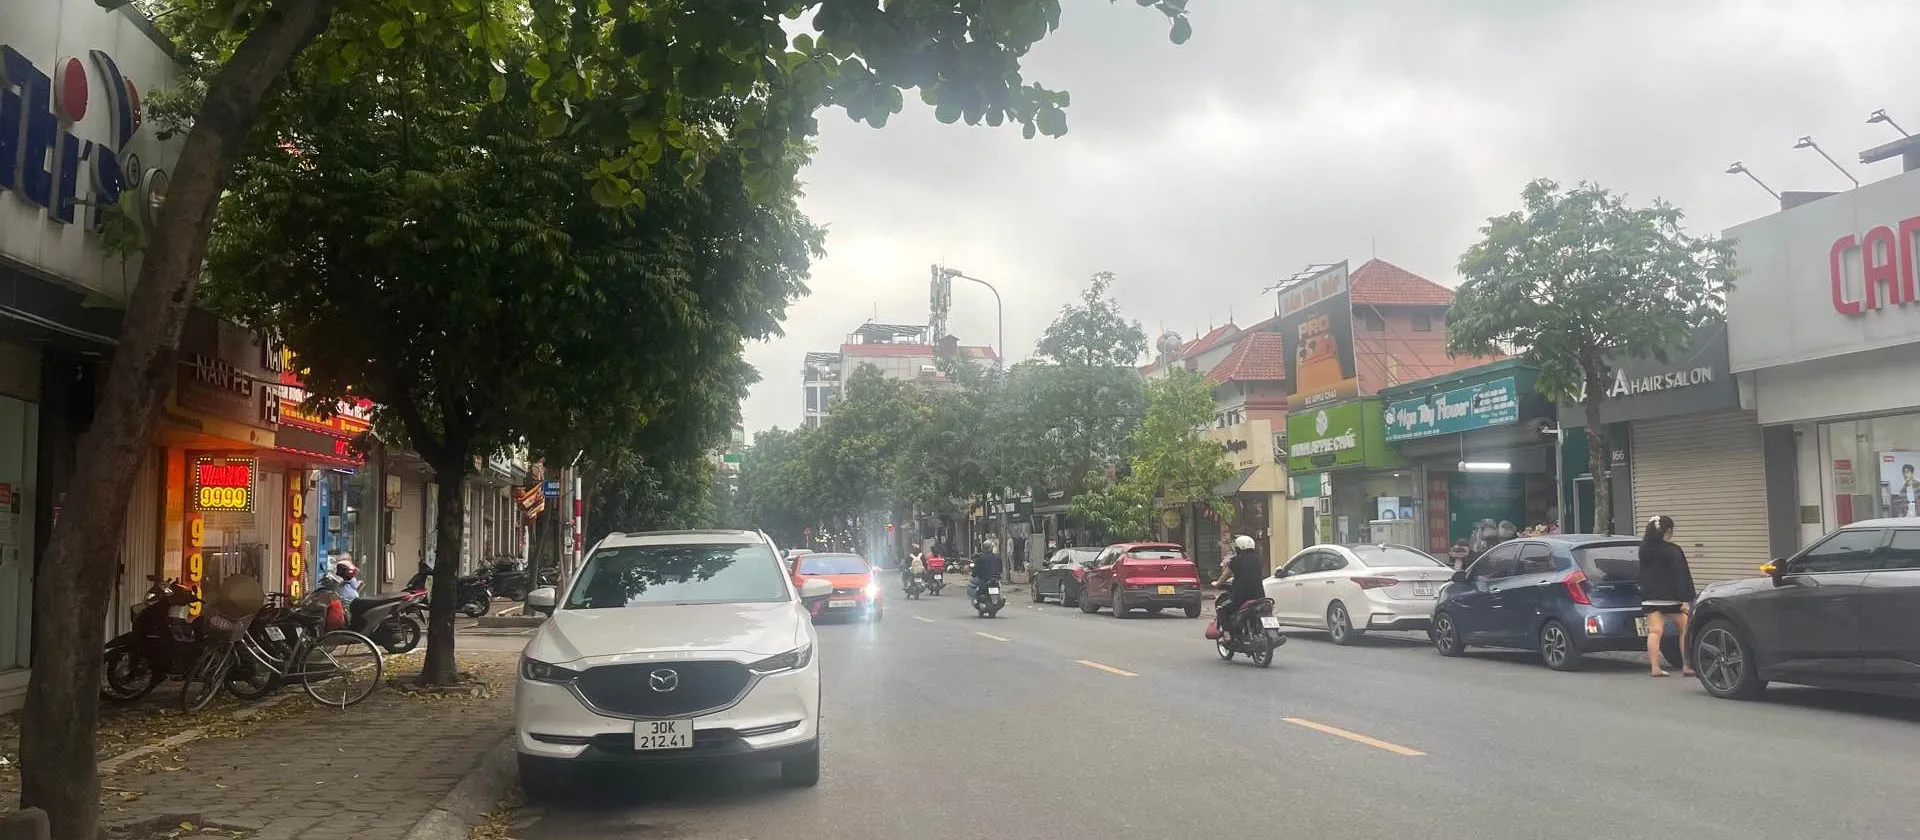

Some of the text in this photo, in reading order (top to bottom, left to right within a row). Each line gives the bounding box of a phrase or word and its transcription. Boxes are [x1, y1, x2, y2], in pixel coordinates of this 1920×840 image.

[196, 353, 229, 389] NAN
[1631, 375, 1664, 394] HAIR
[1664, 366, 1712, 389] SALON
[1436, 395, 1469, 421] Flower
[1612, 450, 1625, 461] 166
[200, 486, 247, 508] 9999
[651, 721, 676, 734] 30K
[640, 734, 685, 748] 212.41
